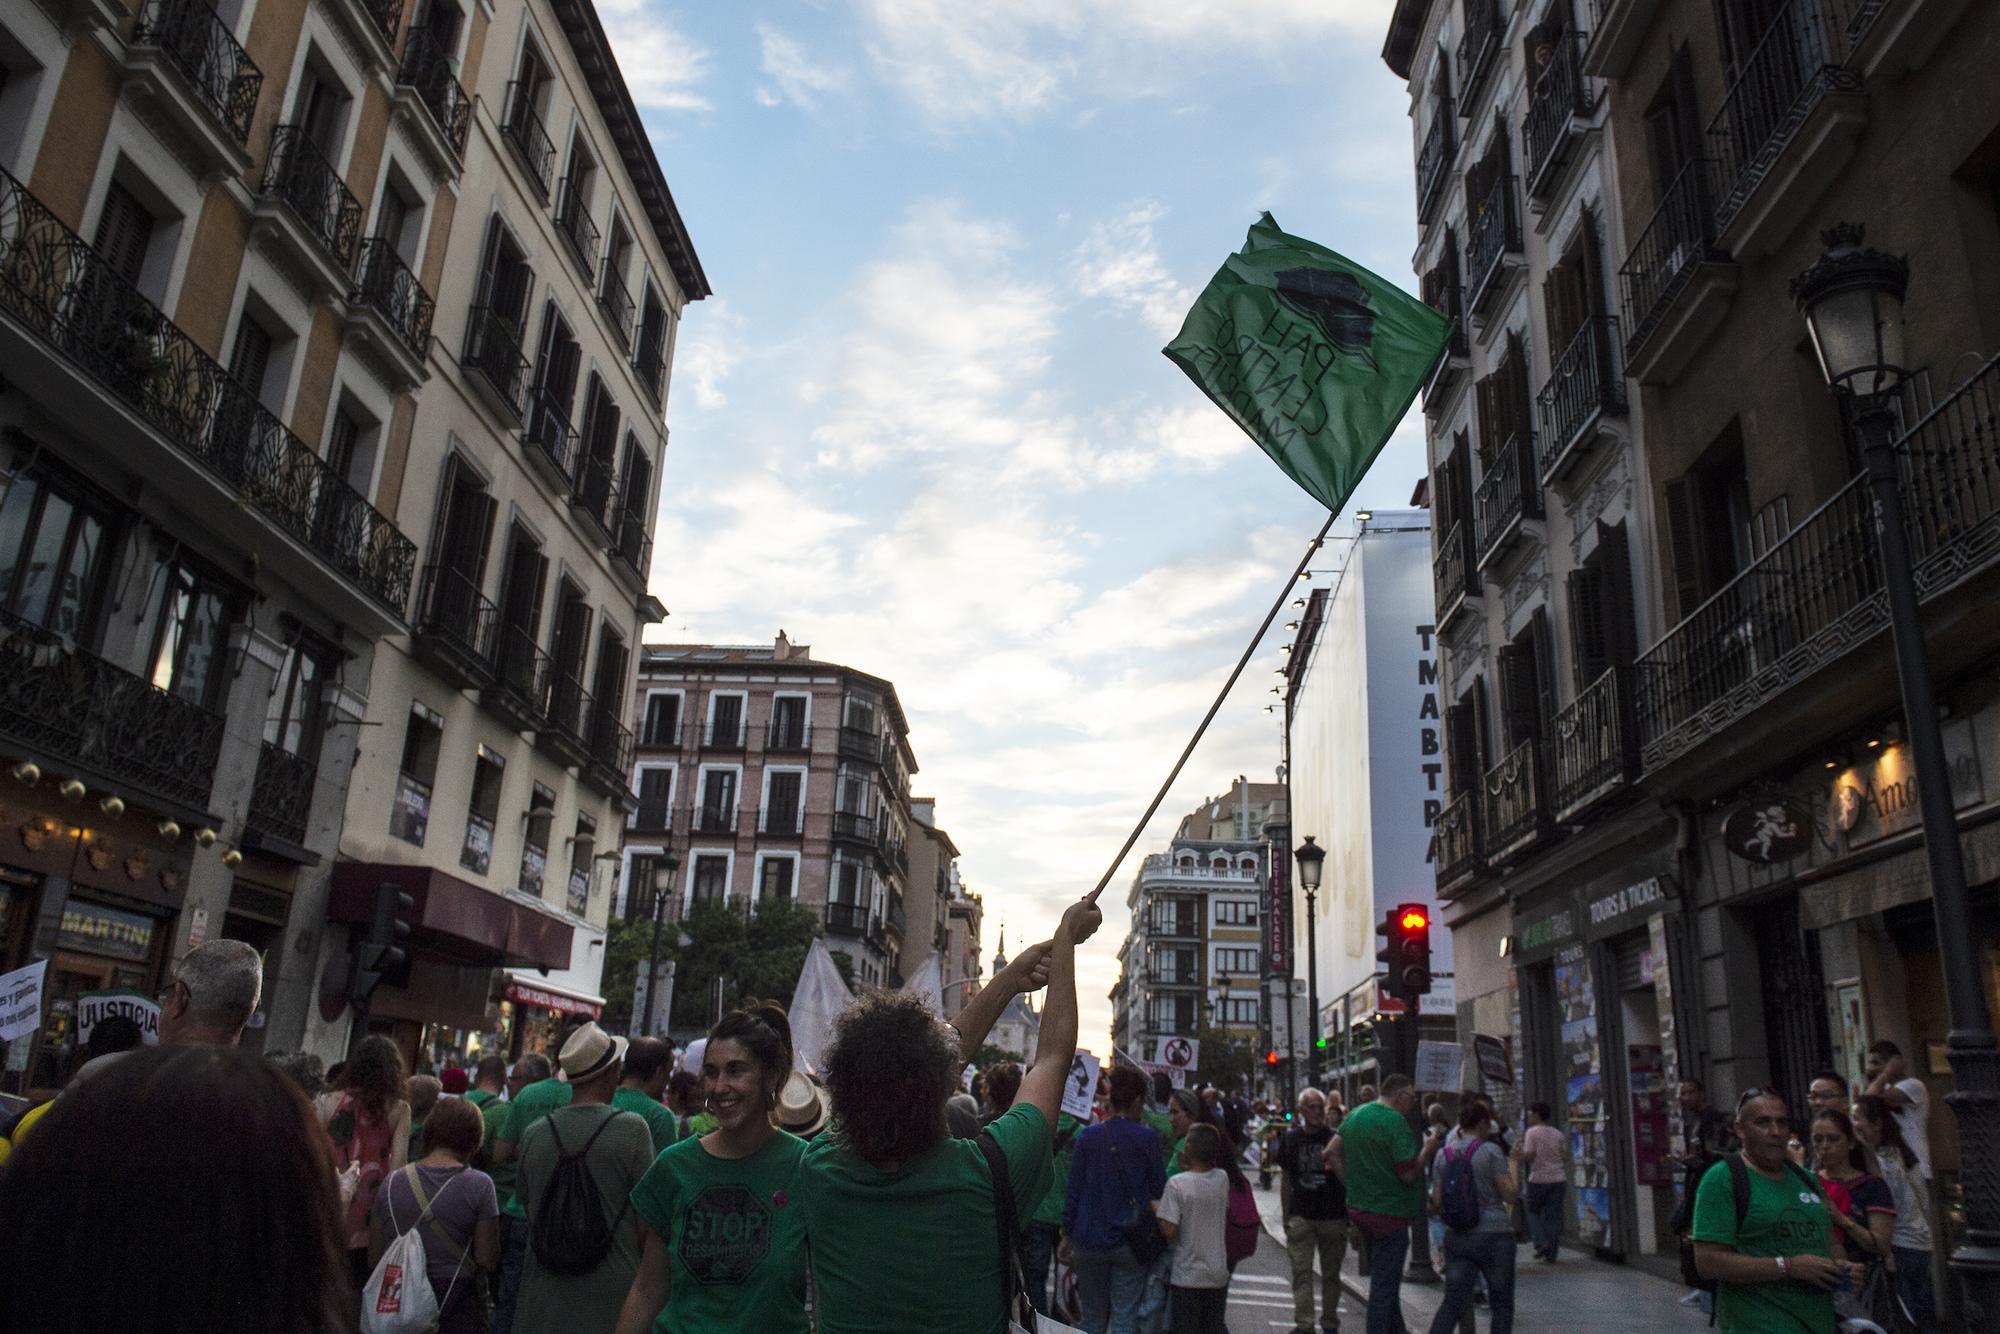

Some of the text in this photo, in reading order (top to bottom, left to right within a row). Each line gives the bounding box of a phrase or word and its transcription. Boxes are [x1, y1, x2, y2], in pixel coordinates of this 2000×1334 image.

[1272, 851, 1281, 951] PETIT PALACE
[60, 911, 150, 946] MARTINI
[80, 1001, 160, 1036] JUSTICIA
[688, 1210, 765, 1241] STOP
[1779, 1220, 1815, 1240] STOP
